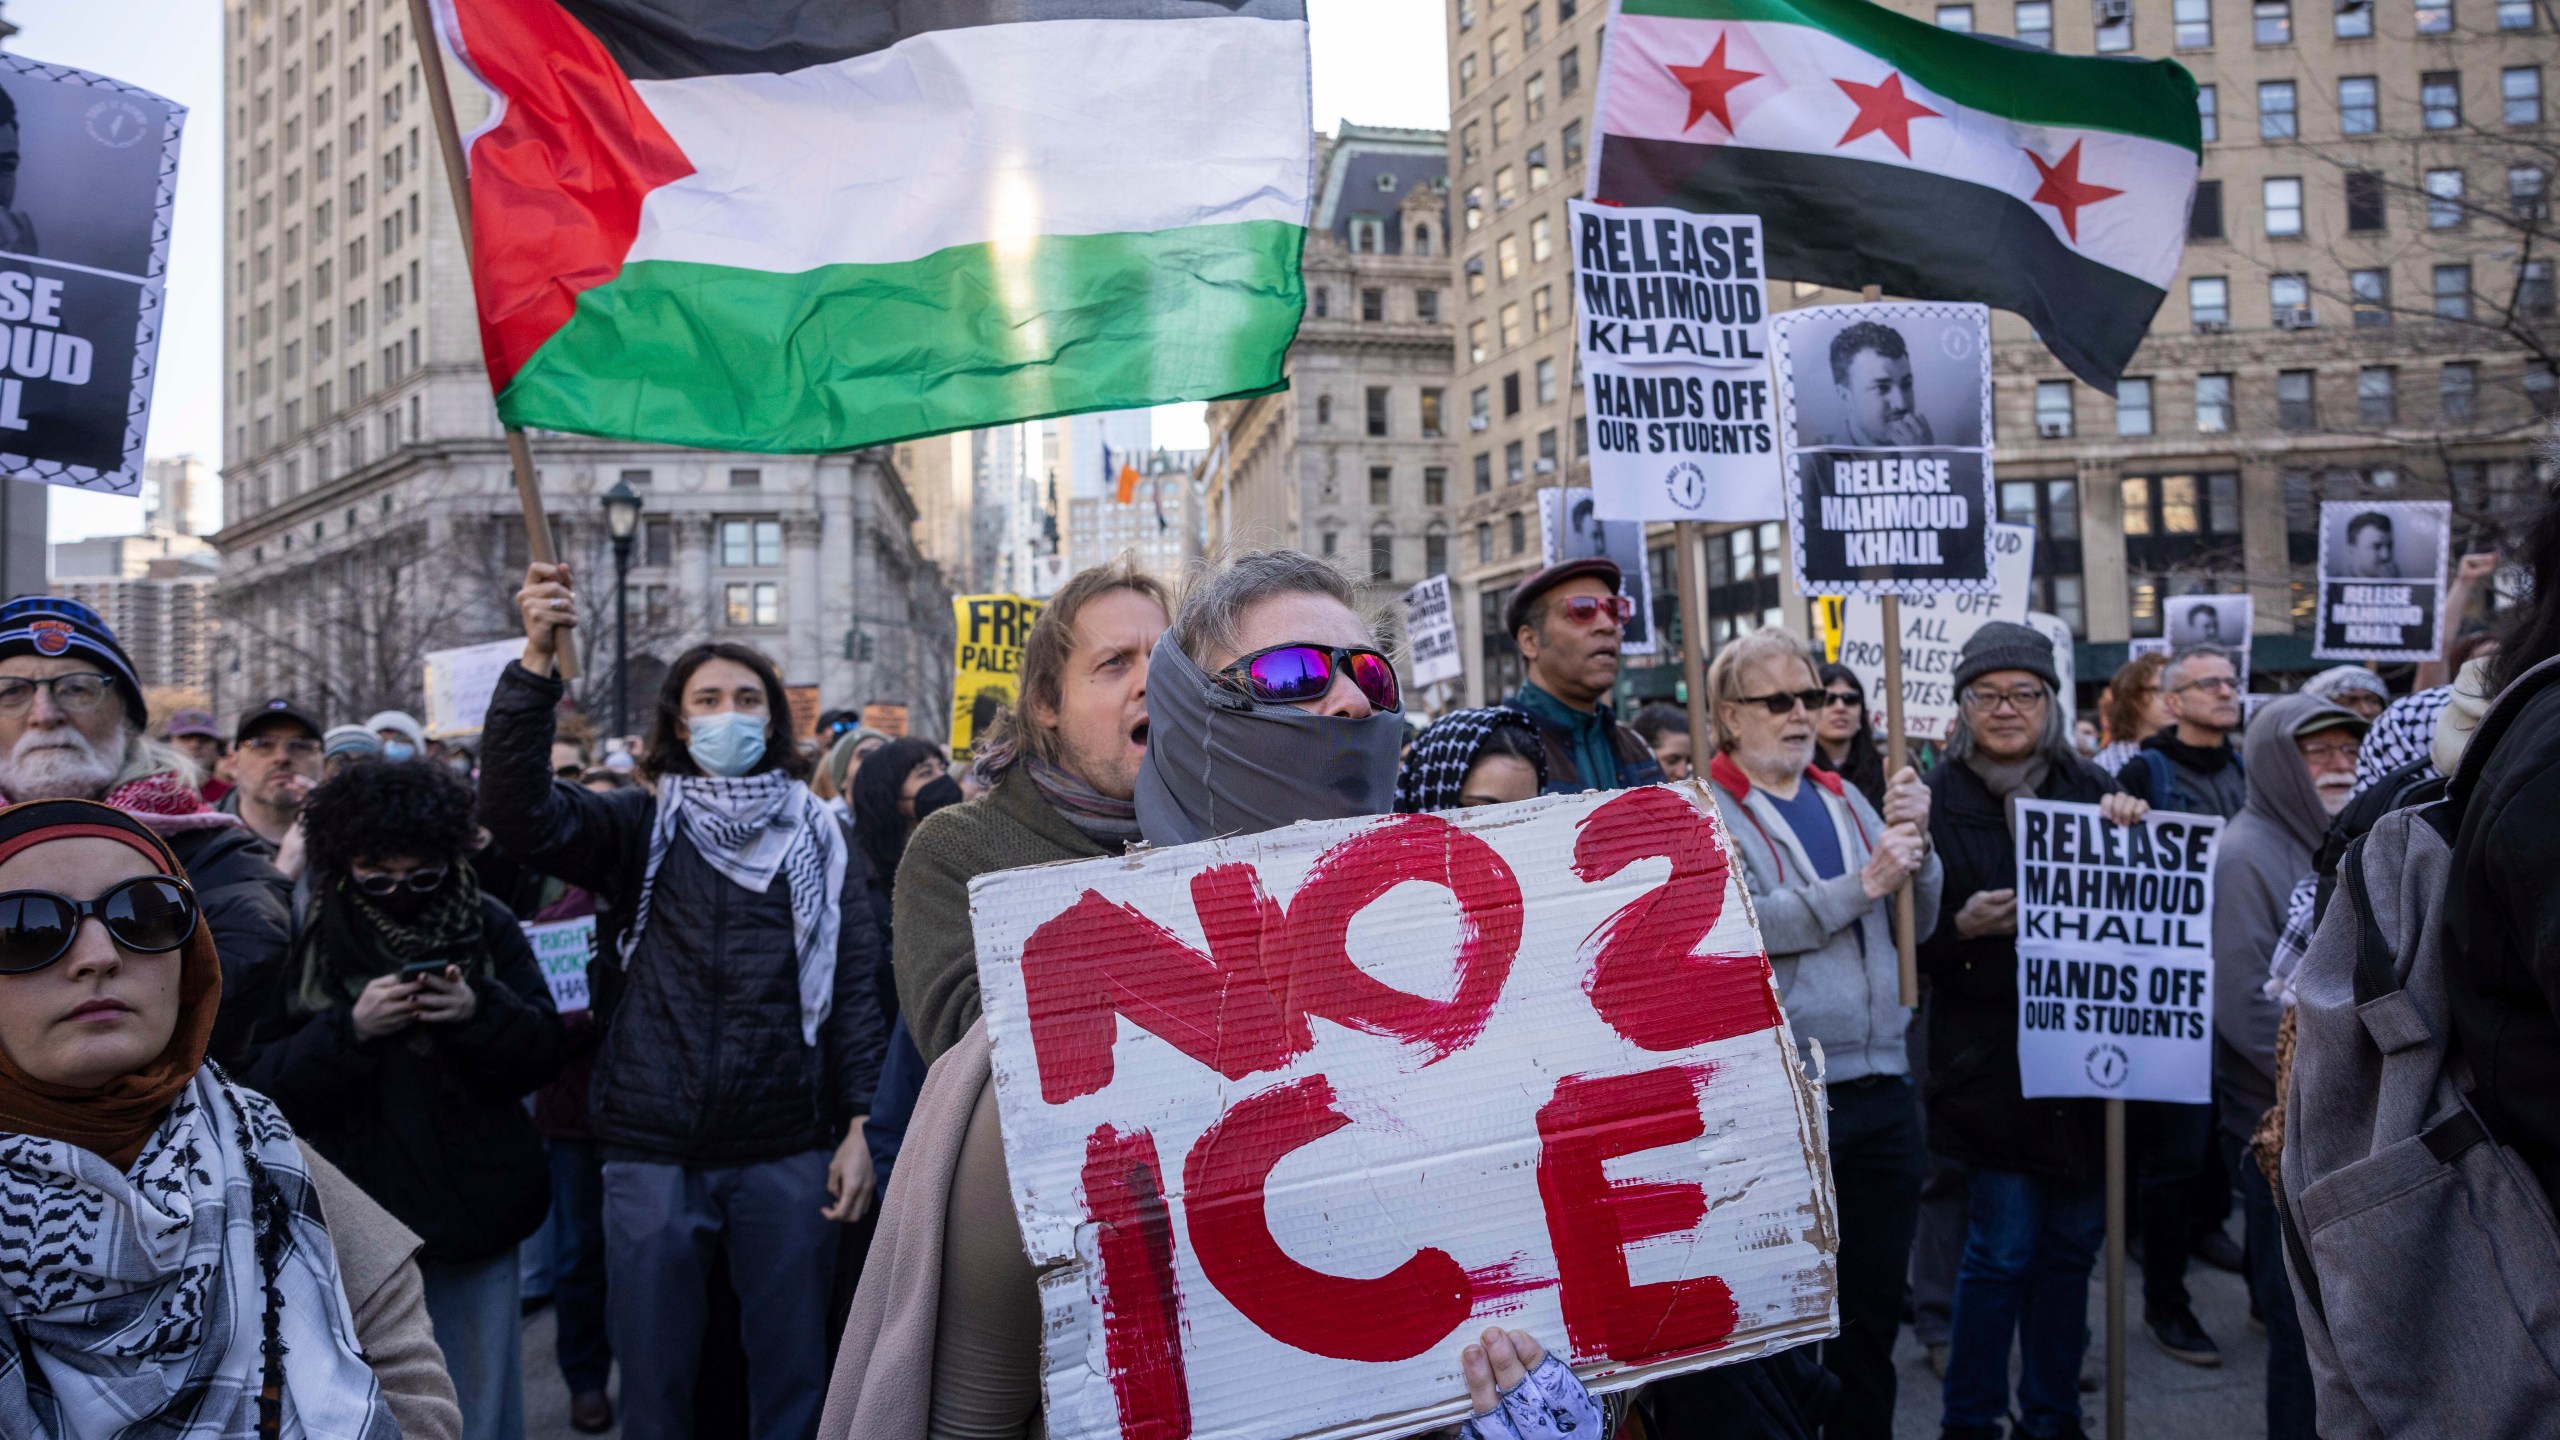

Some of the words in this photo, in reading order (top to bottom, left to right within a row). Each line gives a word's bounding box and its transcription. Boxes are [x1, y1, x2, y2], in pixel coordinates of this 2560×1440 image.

[1578, 213, 1759, 281] RELEASE
[1581, 272, 1761, 325] MAHMOUD
[1588, 320, 1764, 359] KHALIL
[1593, 373, 1703, 420] HANDS
[1712, 379, 1766, 421] OFF
[1597, 418, 1641, 453] OUR
[1648, 421, 1772, 454] STUDENTS
[1834, 459, 1951, 495] RELEASE
[1820, 495, 1969, 531] MAHMOUD
[1844, 531, 1944, 567] KHALIL
[968, 600, 1041, 648] FRE
[1956, 593, 2002, 617] OFF
[1905, 616, 1950, 643] ALL
[961, 645, 1025, 673] PALES
[2025, 809, 2215, 873] RELEASE
[2025, 865, 2206, 915] MAHMOUD
[1022, 813, 1525, 1106] NO
[1570, 785, 1784, 1051] 2
[2026, 909, 2205, 948] KHALIL
[2026, 957, 2138, 1004] HANDS
[2149, 966, 2206, 1008] OFF
[2025, 1001, 2065, 1030] OUR
[2074, 1004, 2205, 1040] STUDENTS
[1072, 1065, 1740, 1440] ICE
